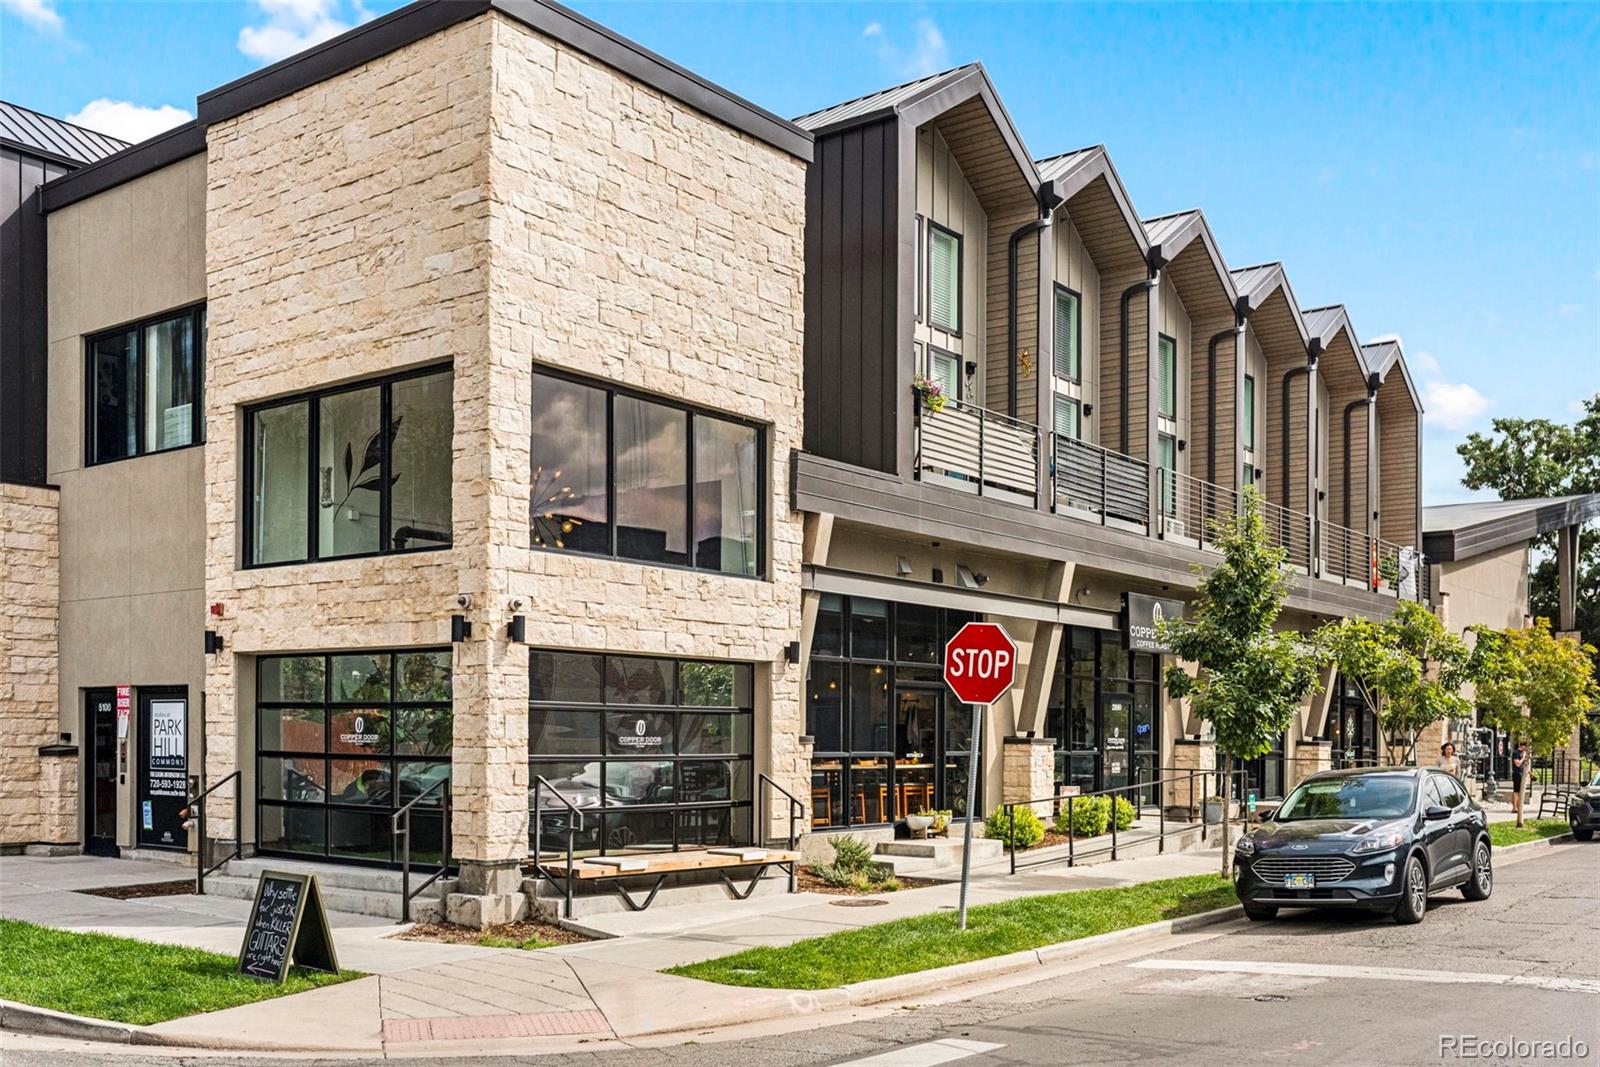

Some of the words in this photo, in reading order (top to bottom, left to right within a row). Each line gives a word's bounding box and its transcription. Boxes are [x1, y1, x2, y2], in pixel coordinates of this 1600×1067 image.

[1130, 625, 1157, 639] COPPE
[1136, 640, 1155, 649] COFFEE
[950, 647, 1010, 679] STOP
[117, 687, 130, 696] FIRE
[98, 703, 112, 712] 5100
[153, 719, 183, 736] PARK
[153, 737, 183, 757] HILL
[151, 758, 185, 766] COMMONS
[263, 881, 279, 907] Why
[270, 917, 293, 935] KILLER
[248, 929, 288, 957] GUITARS
